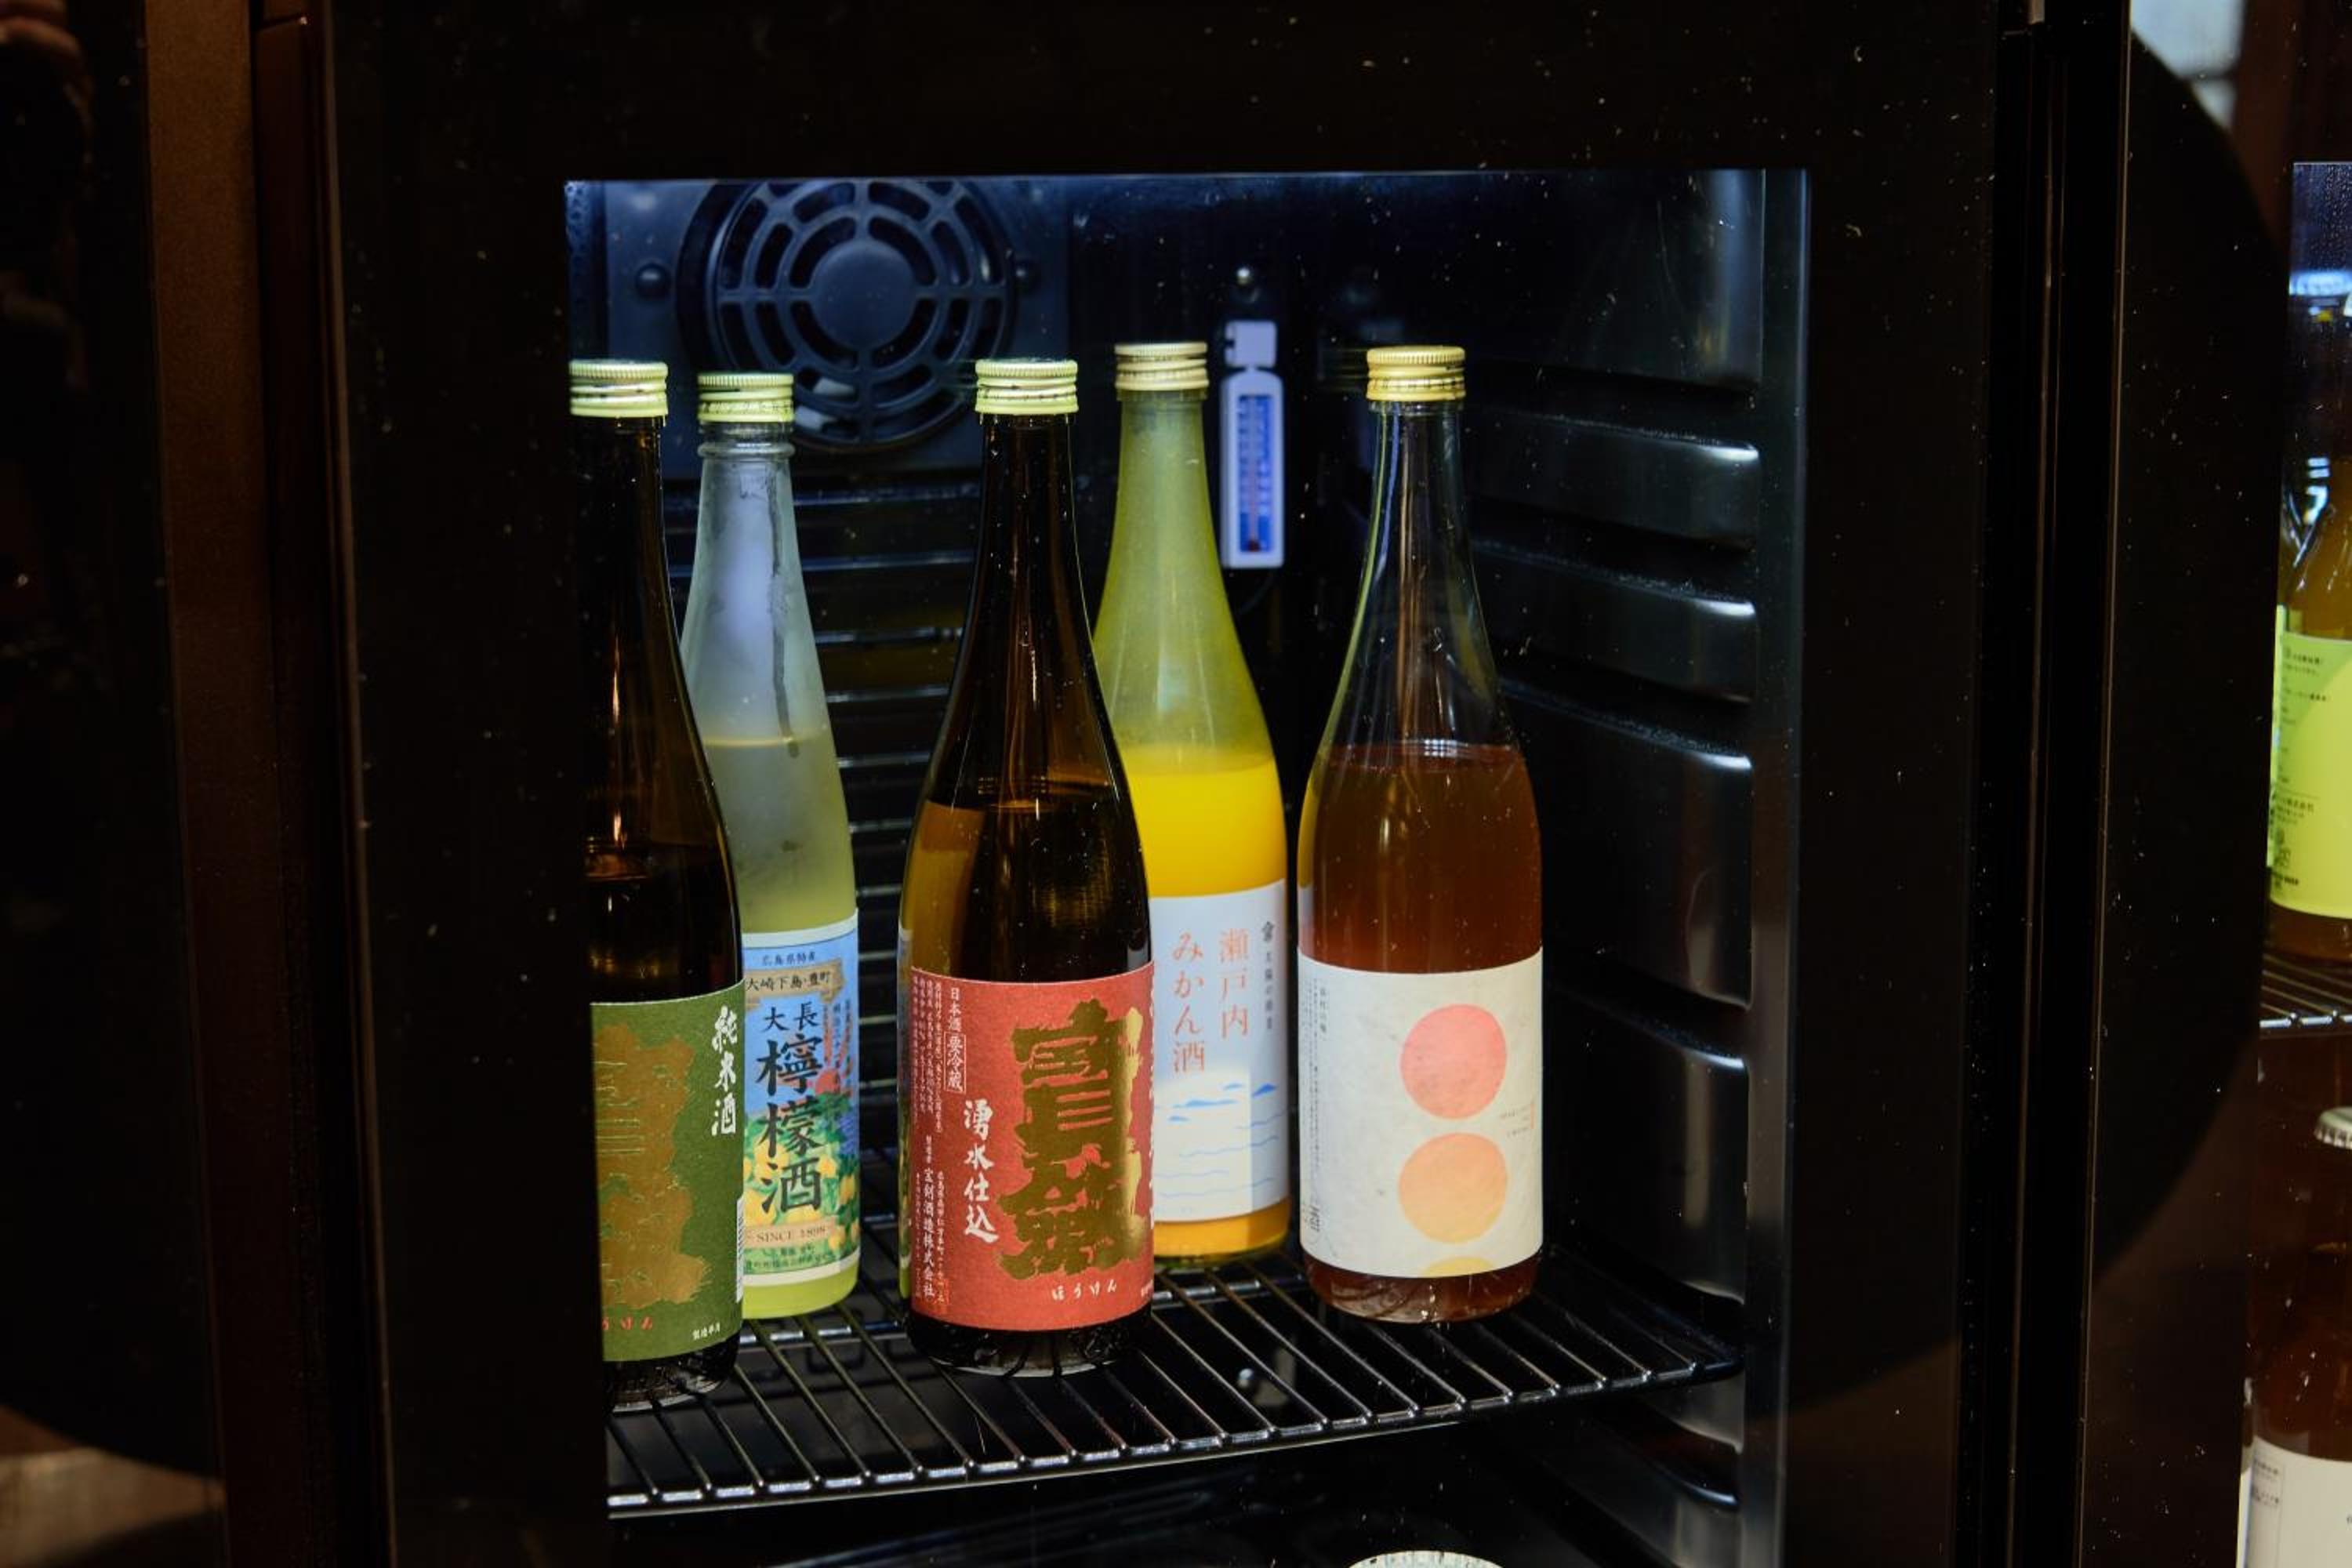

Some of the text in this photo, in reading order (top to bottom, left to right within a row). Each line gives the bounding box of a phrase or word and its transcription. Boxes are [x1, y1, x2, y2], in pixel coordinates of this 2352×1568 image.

[711, 1005, 738, 1136] 純米酒
[1172, 931, 1205, 1074] みかん酒
[755, 1033, 823, 1214] 檸檬酒
[964, 1098, 1000, 1243] 湧水仕込
